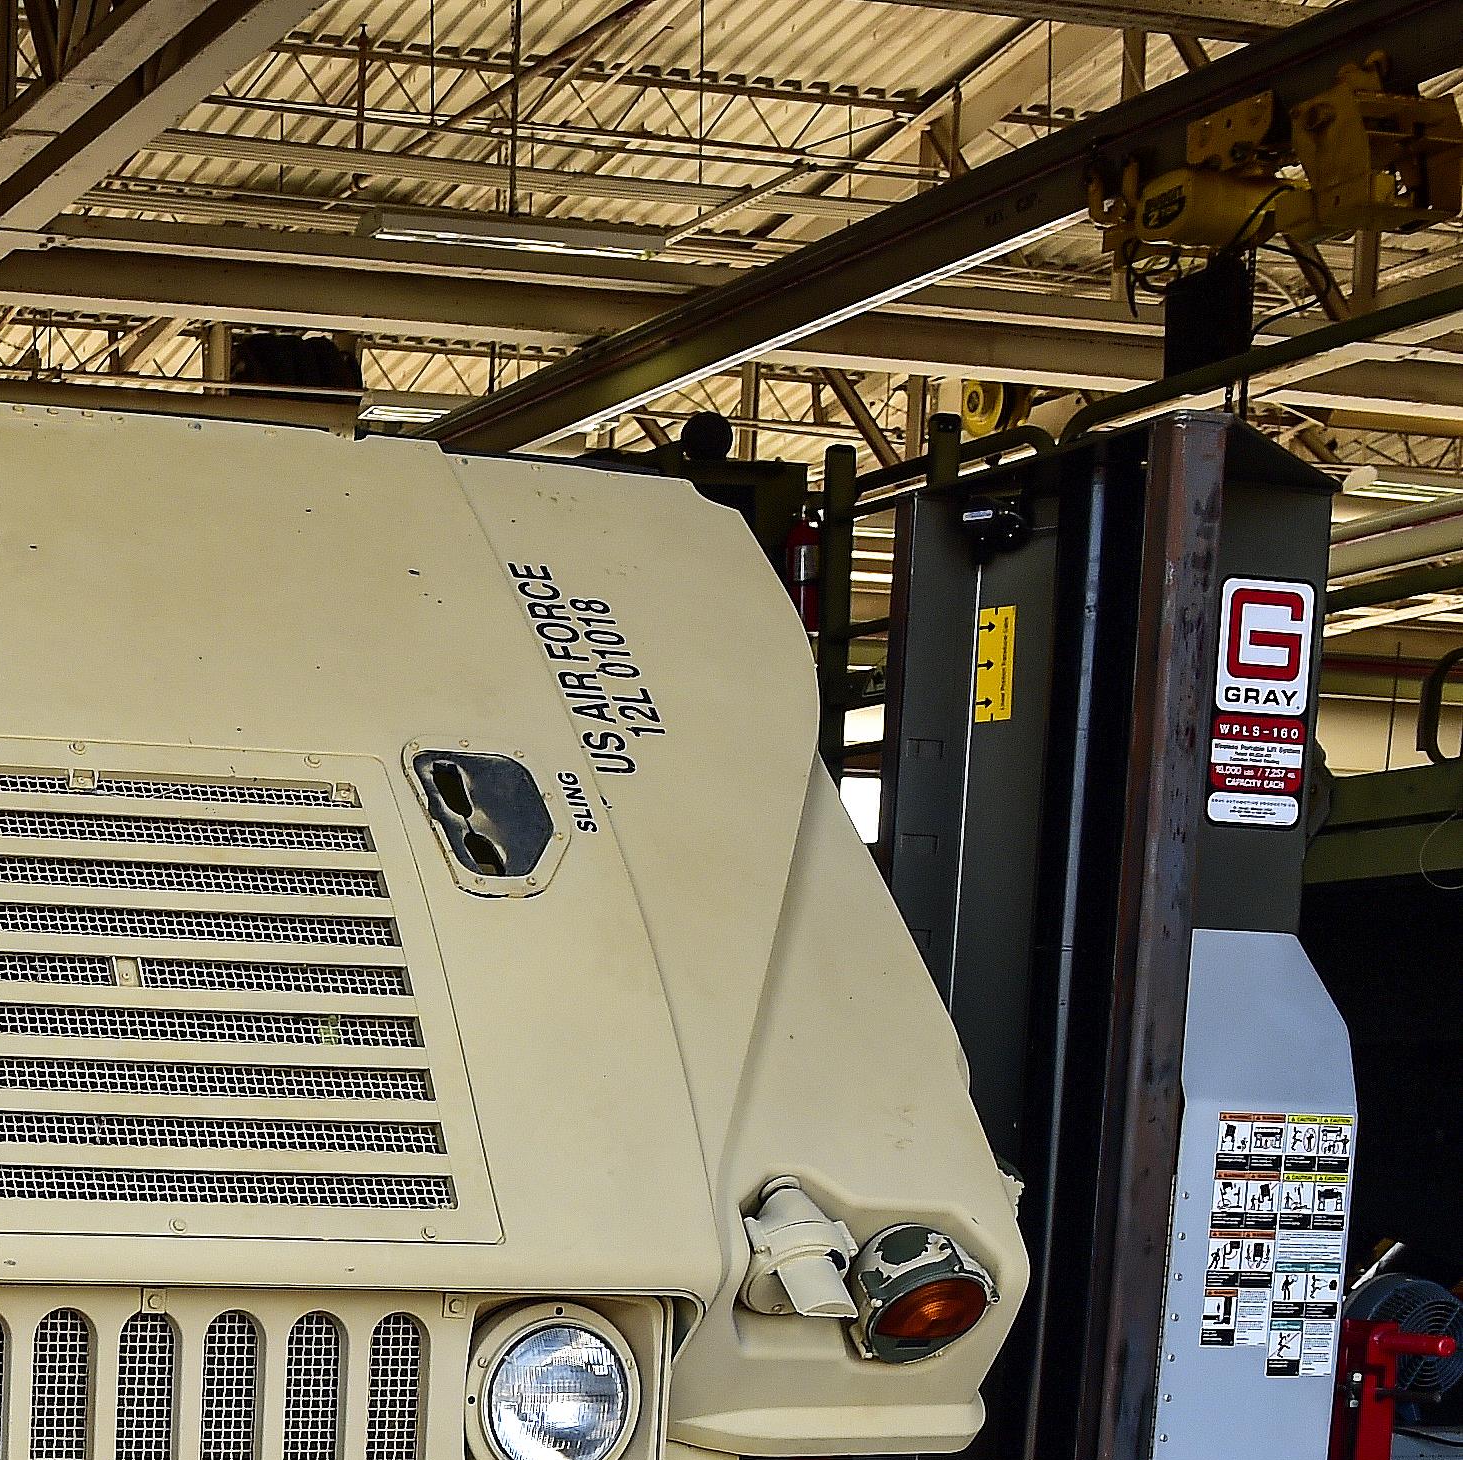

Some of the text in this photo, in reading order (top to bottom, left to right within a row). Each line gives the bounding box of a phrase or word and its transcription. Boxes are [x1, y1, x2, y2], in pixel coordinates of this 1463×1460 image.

[507, 561, 637, 775] US AIR FORCE
[569, 598, 666, 738] 12L 01018
[1227, 587, 1304, 682] G
[1219, 724, 1299, 739] WPLS-160
[1225, 686, 1298, 707] GRAY
[556, 772, 598, 833] SLING
